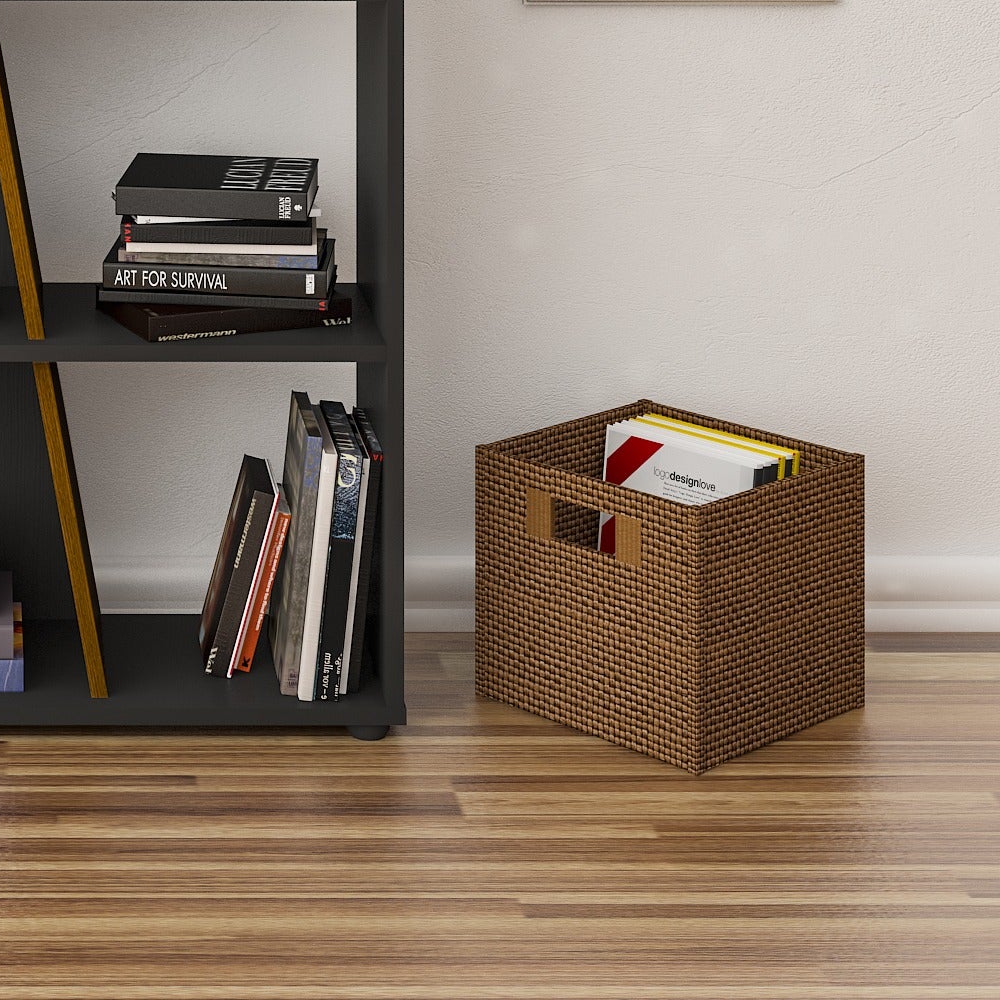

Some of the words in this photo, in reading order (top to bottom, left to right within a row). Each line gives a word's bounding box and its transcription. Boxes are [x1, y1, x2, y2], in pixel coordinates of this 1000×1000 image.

[284, 197, 292, 219] FREUD
[114, 269, 137, 287] ART
[142, 270, 168, 288] FOR
[171, 271, 228, 290] SURVIVAL
